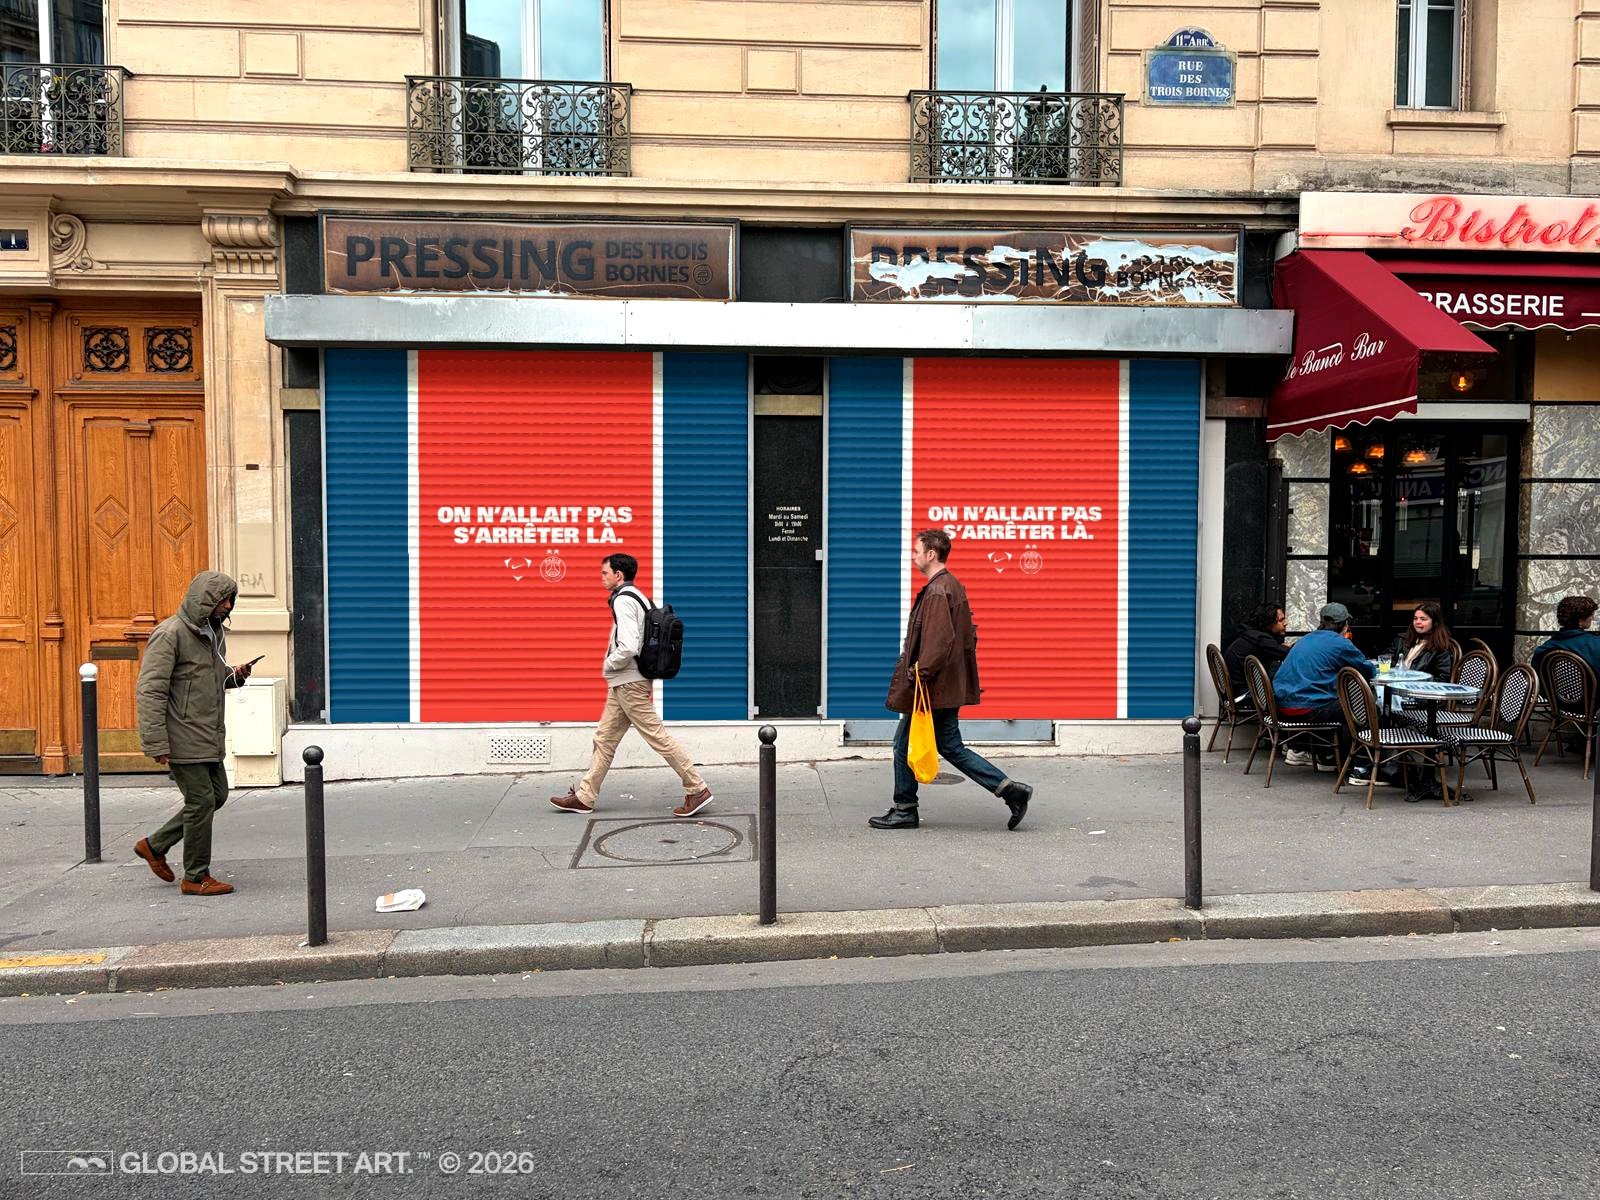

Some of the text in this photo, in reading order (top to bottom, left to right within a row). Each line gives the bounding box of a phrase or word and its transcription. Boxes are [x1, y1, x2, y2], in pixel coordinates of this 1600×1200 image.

[1178, 60, 1204, 72] RUE
[1179, 74, 1203, 84] DES
[1150, 86, 1231, 98] TROIS BORNES
[346, 234, 596, 282] PRESSING
[605, 240, 708, 261] DES TROIS
[605, 264, 690, 283] BORNES
[1299, 342, 1345, 376] Banco
[1350, 332, 1388, 361] Bar
[437, 506, 633, 524] ON N’ALLAIT PAS
[928, 506, 1102, 521] ON N’ALLAIT PAS
[453, 522, 624, 544] S’ARRÊTER LÀ.
[943, 521, 1094, 540] S’ARRÊTER LÀ.
